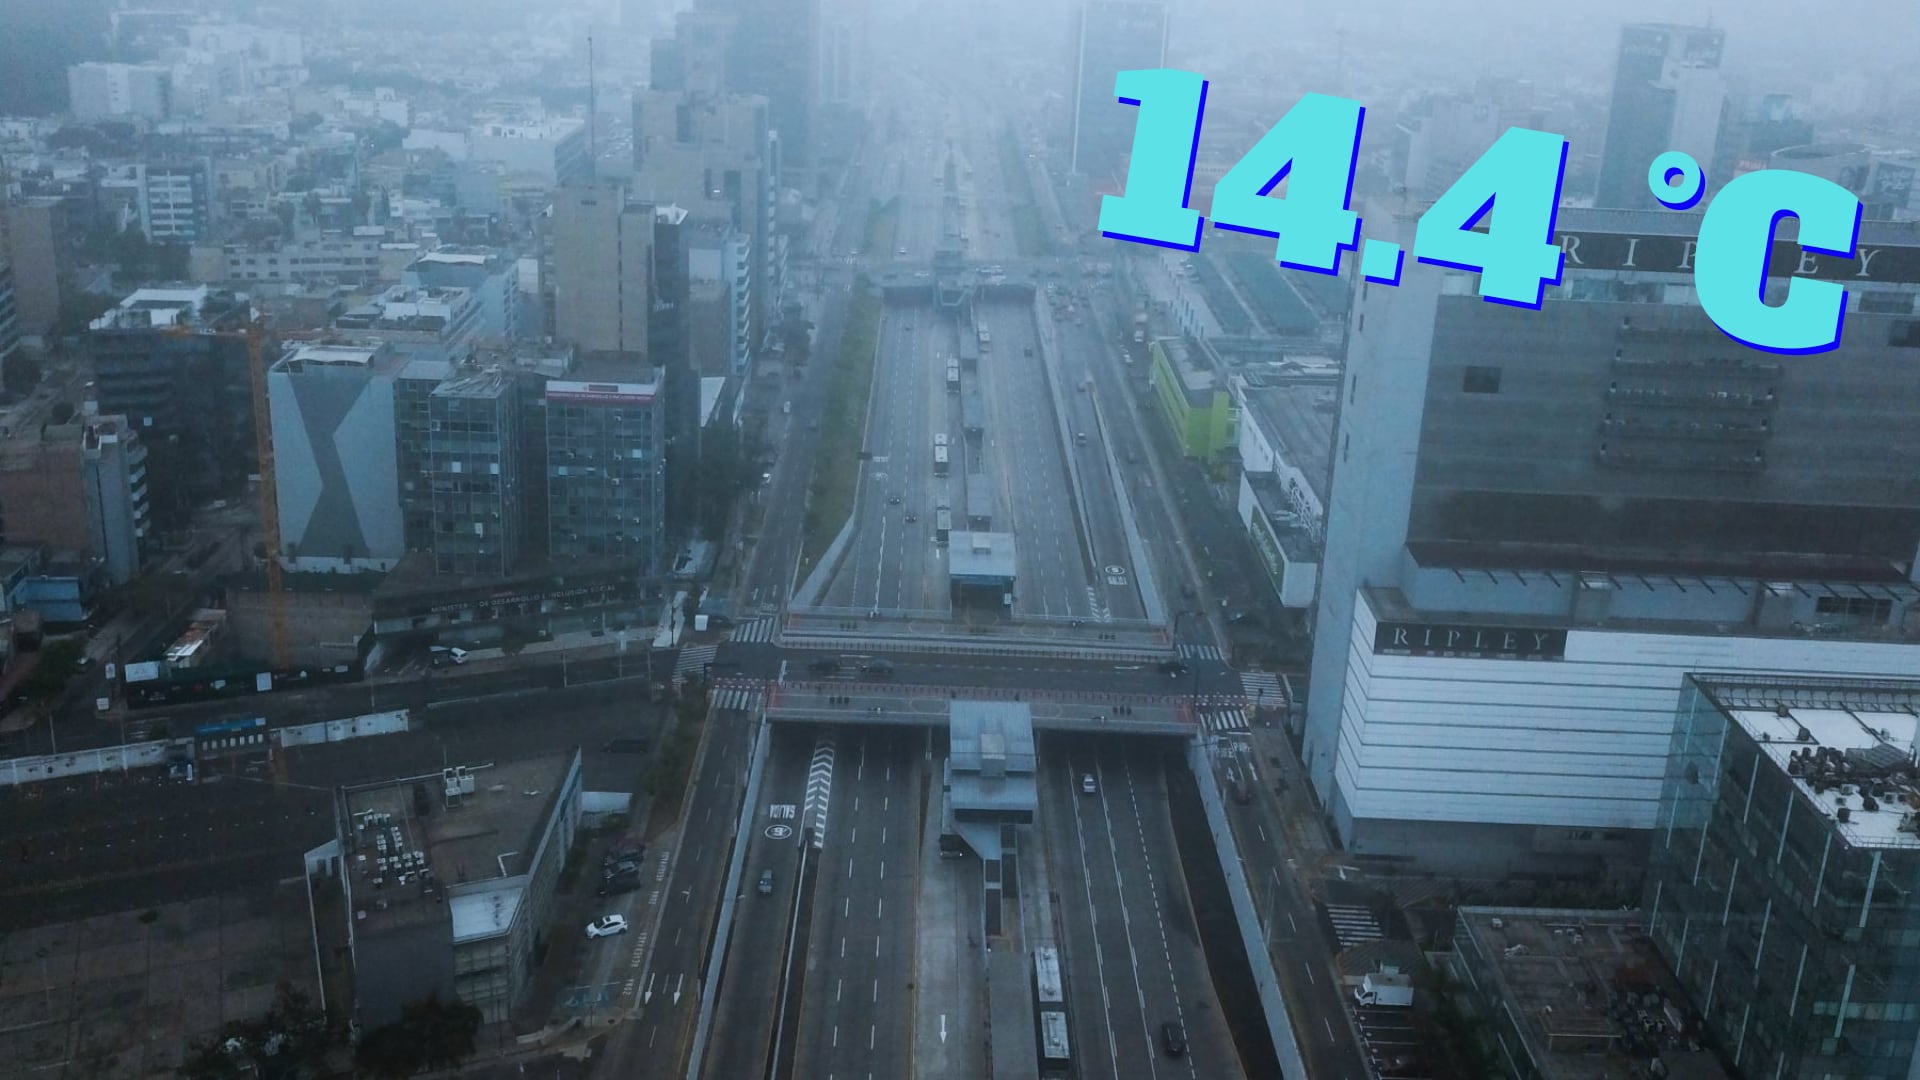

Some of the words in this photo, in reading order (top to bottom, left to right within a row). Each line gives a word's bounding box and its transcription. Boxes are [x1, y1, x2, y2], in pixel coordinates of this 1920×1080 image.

[1559, 234, 1881, 278] RIPEY
[1393, 627, 1549, 650] RIPLEY
[770, 804, 796, 819] SALIDA
